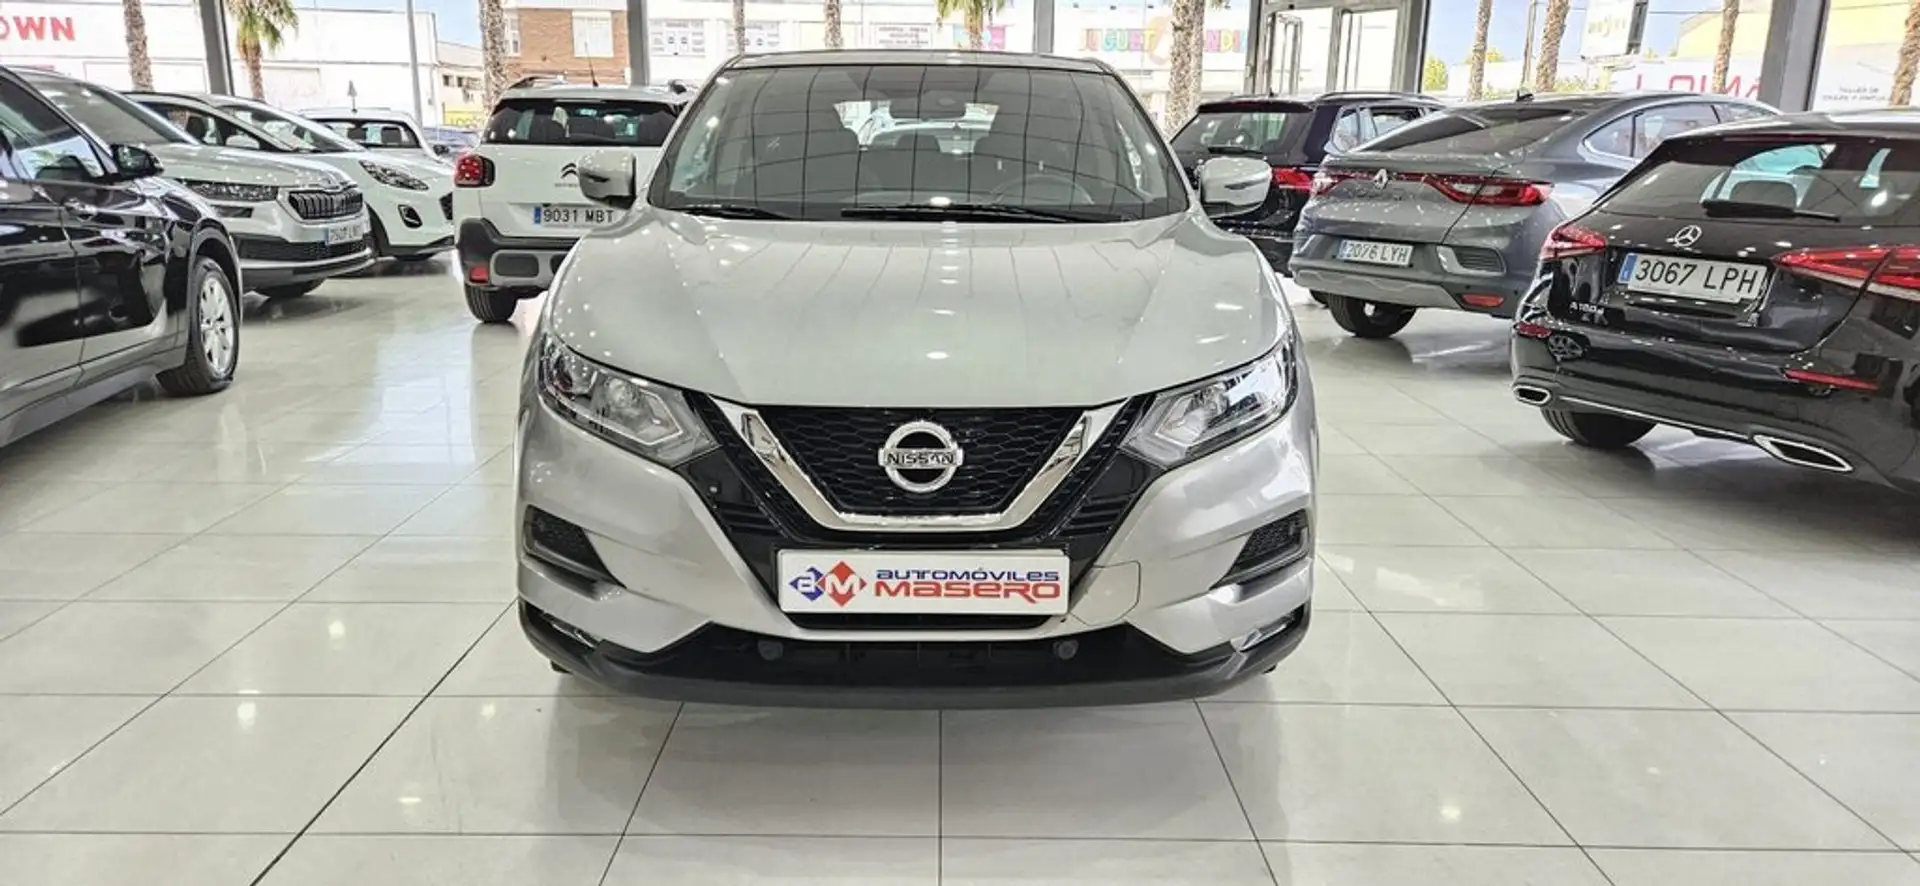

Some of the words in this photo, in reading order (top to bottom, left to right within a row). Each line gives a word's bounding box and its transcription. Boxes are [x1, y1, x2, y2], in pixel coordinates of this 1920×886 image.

[543, 208, 578, 223] 9031
[585, 209, 614, 223] MBT
[1379, 245, 1409, 263] LYH
[1635, 259, 1697, 287] 3067
[1702, 265, 1758, 294] LPH
[887, 451, 954, 464] NISSAN
